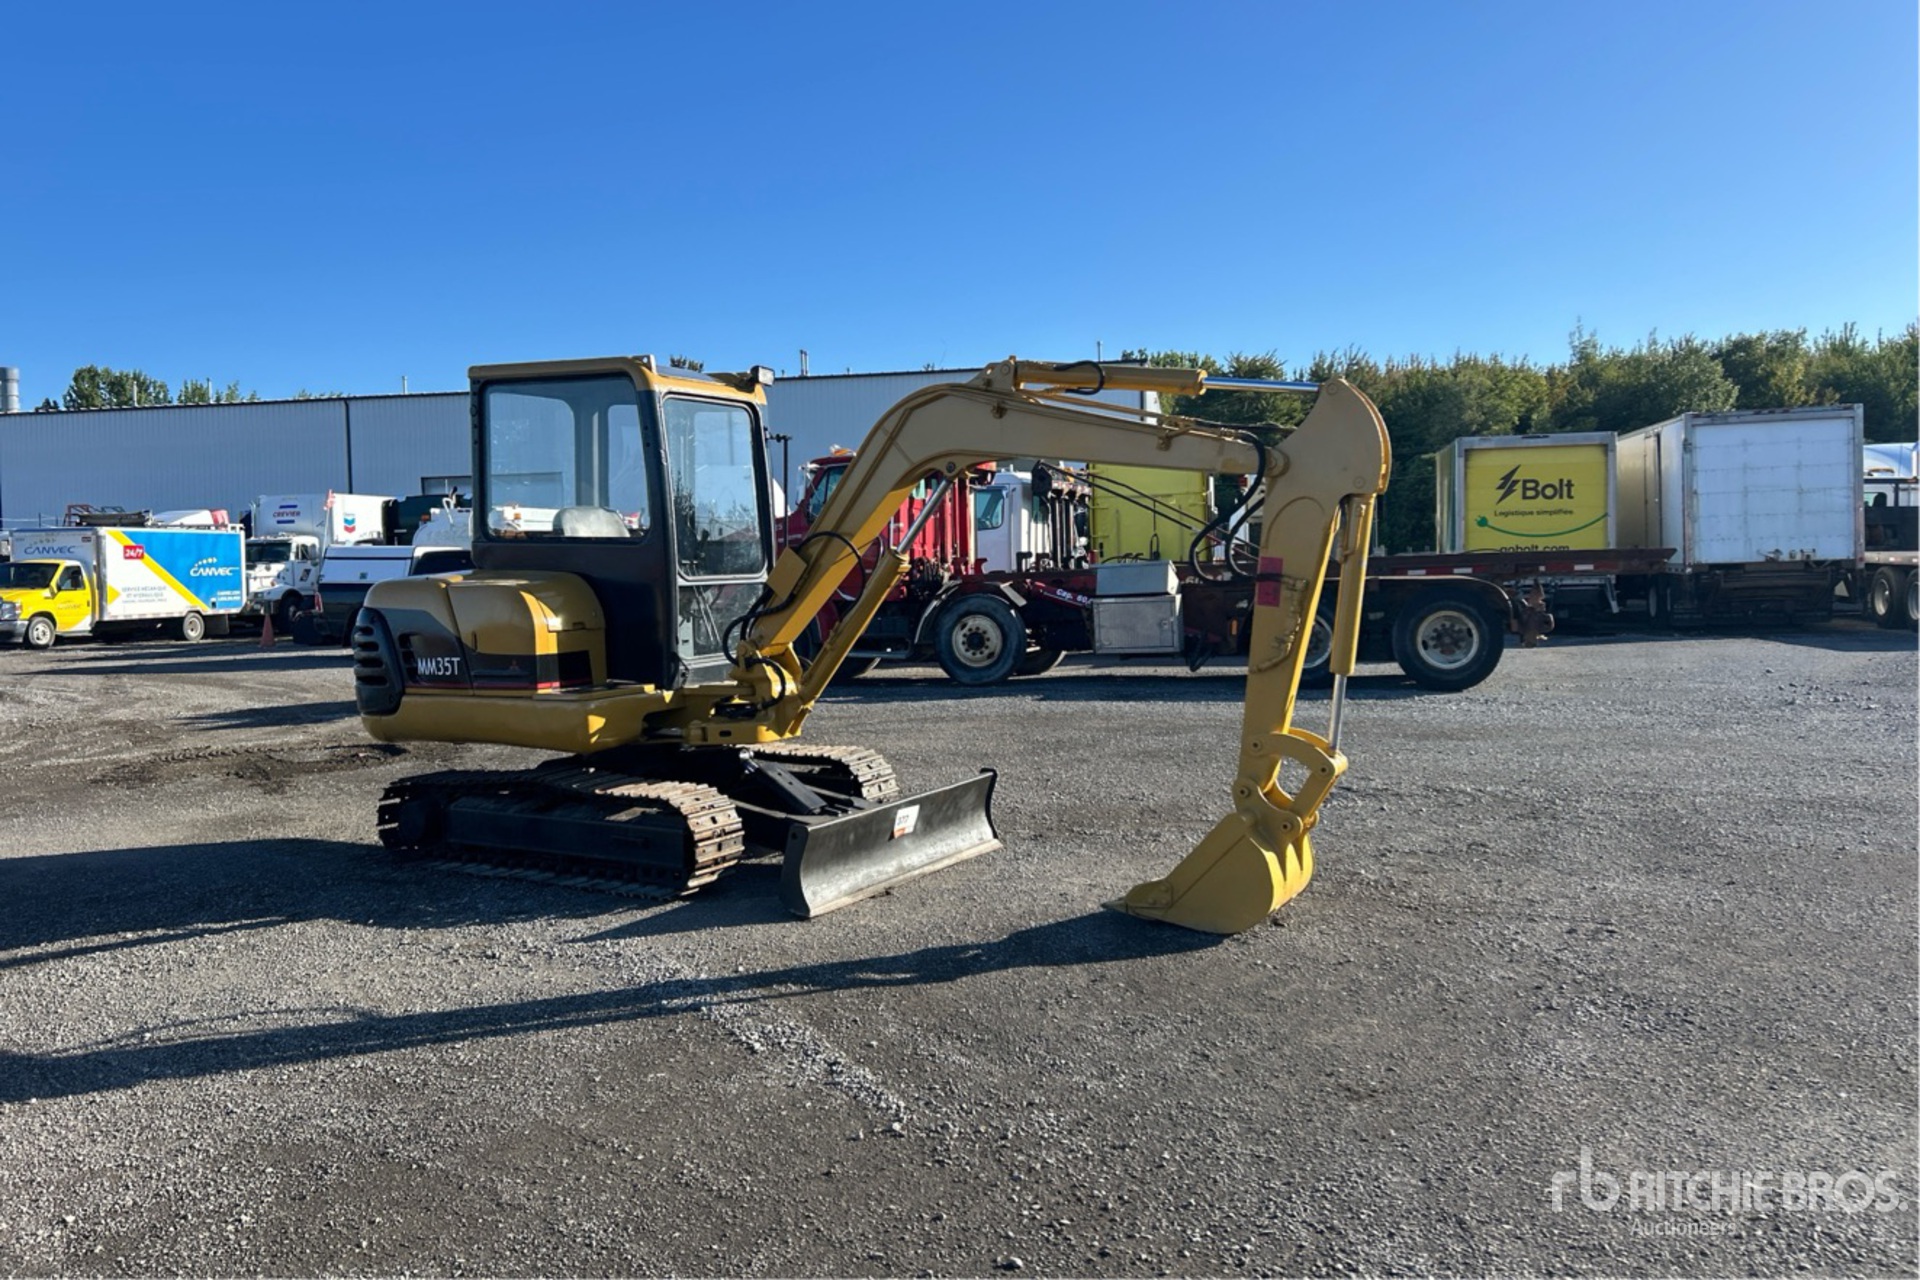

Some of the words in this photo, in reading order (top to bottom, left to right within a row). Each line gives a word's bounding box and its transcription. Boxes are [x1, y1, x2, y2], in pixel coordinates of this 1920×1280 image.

[1522, 478, 1574, 500] Bolt
[1494, 509, 1535, 517] Logistique
[24, 545, 76, 555] CANVEC
[123, 548, 144, 559] 24/7
[190, 566, 239, 577] CANVEC
[417, 657, 460, 676] MM35T
